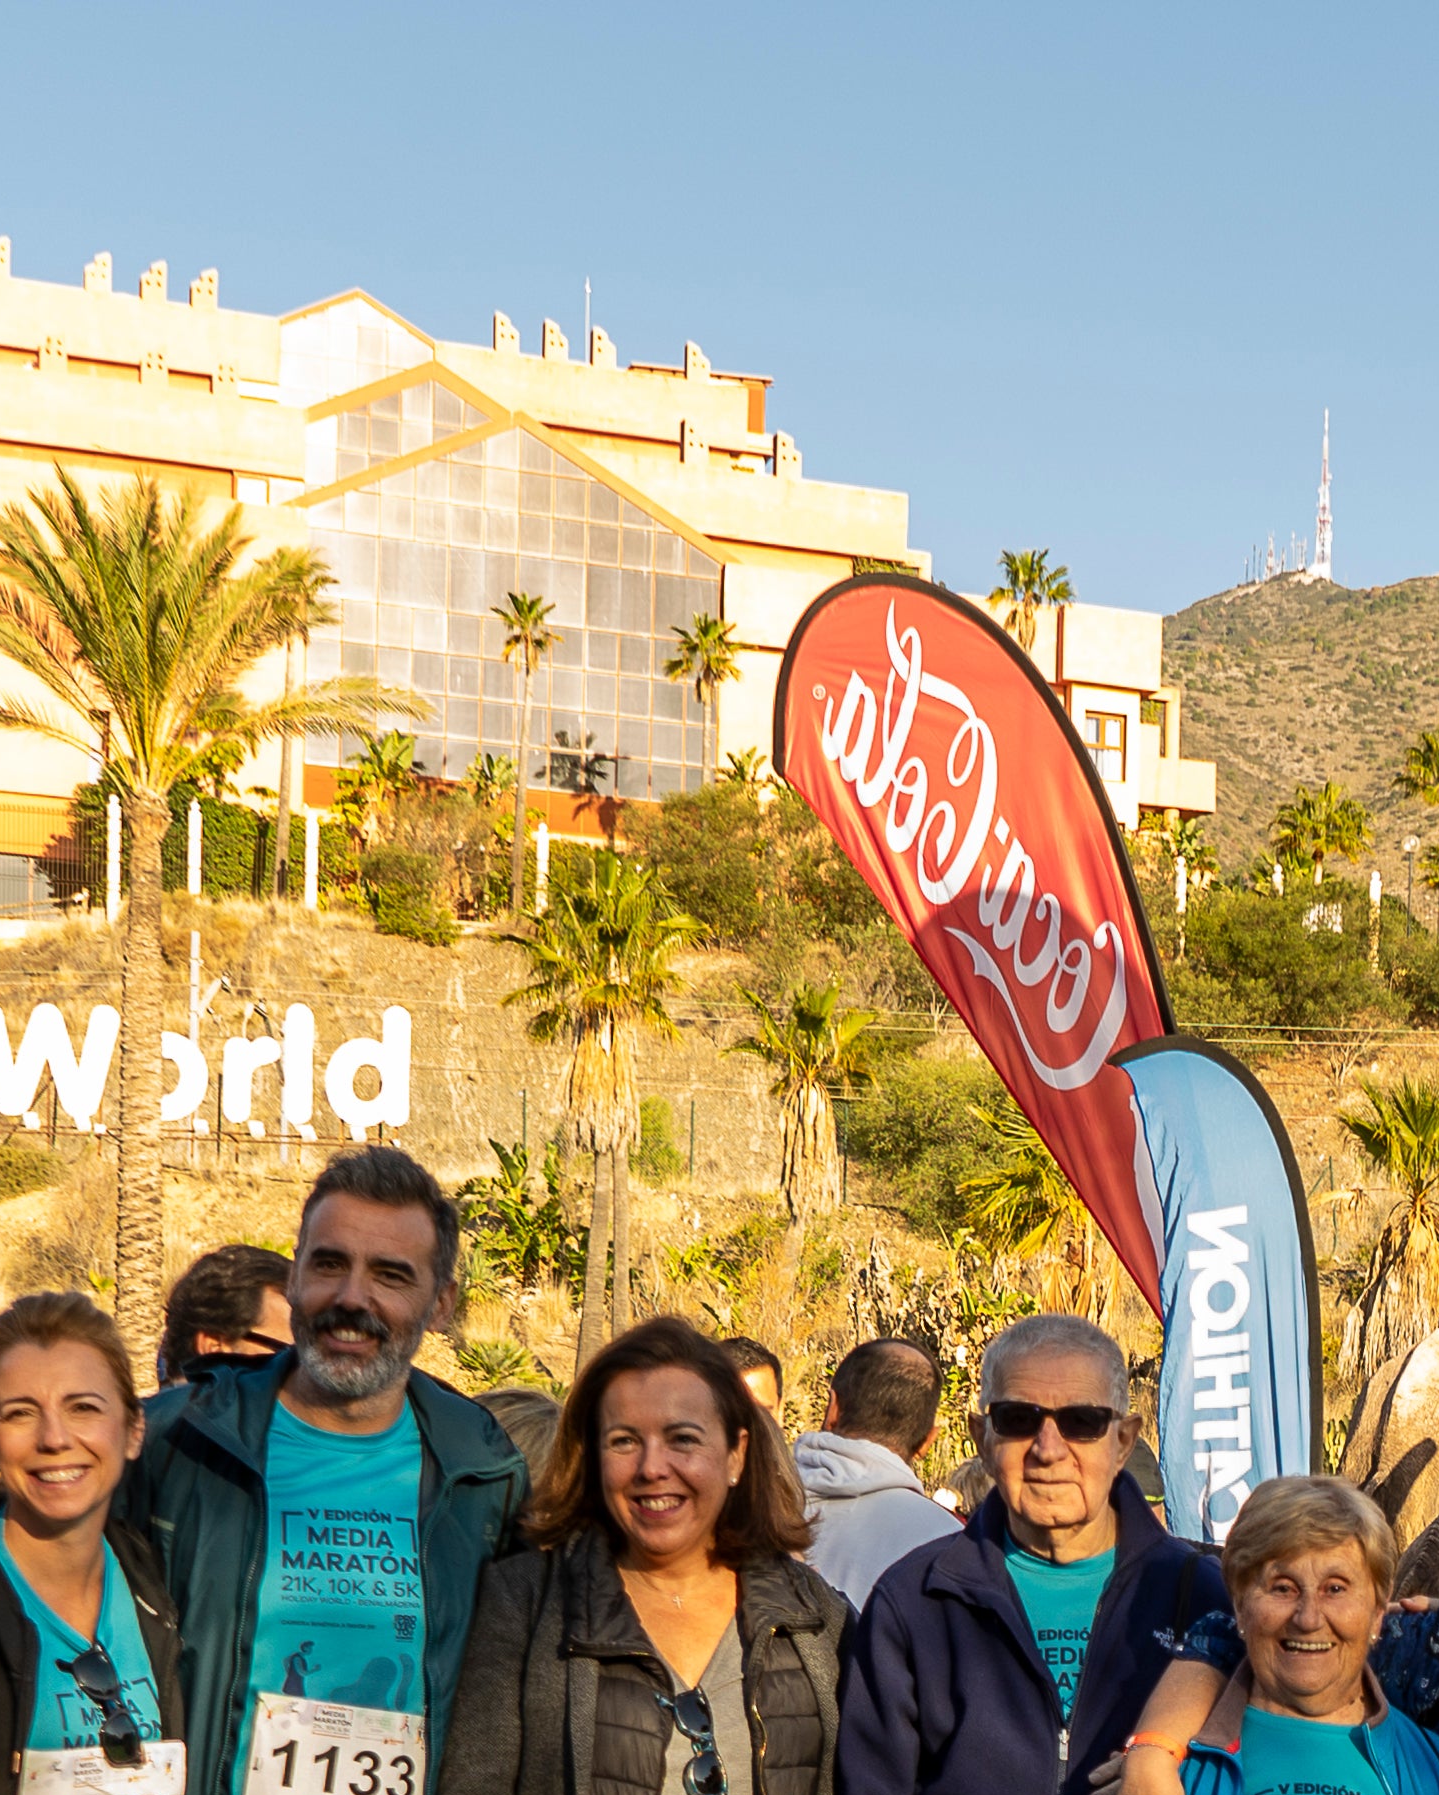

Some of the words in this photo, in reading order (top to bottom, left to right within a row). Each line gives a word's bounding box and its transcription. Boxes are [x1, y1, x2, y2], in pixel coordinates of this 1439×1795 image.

[307, 1508, 320, 1520] V
[323, 1509, 392, 1524] EDICIÓN
[307, 1527, 394, 1549] MEDIA
[281, 1550, 419, 1577] MARATÓN
[281, 1576, 322, 1595] 21K,
[328, 1579, 366, 1596] 10K
[372, 1581, 387, 1597] &
[393, 1582, 421, 1599] 5K
[1037, 1627, 1091, 1642] EDICIÓ
[1278, 1784, 1290, 1795] V
